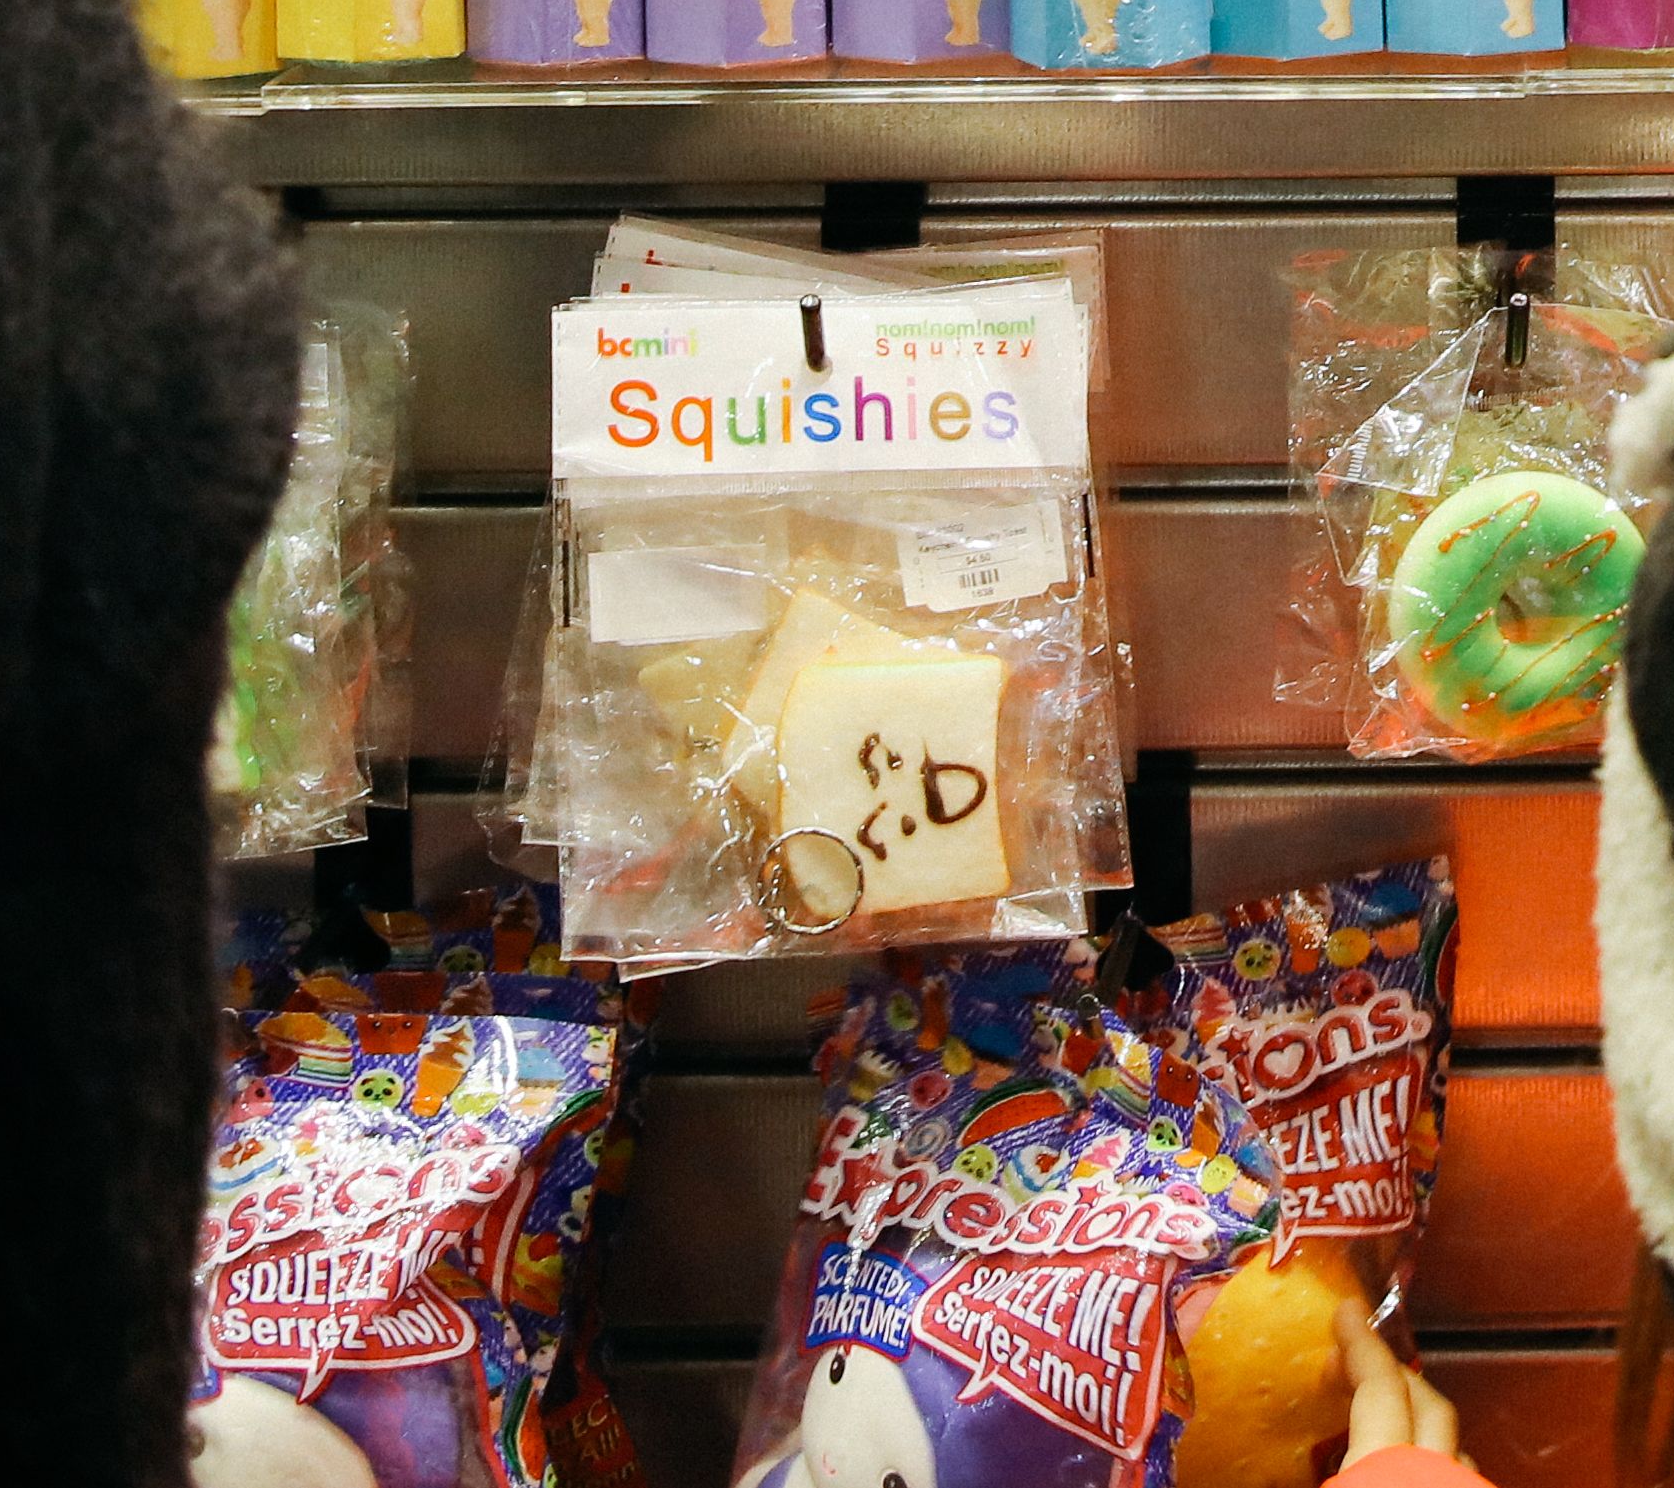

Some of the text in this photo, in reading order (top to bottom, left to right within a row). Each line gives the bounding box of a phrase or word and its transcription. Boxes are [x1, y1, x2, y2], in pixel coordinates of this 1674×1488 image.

[597, 327, 698, 358] bcmini
[876, 315, 1035, 338] nom!nom!nom!
[608, 376, 1019, 463] Squishies
[227, 1240, 391, 1306] SQUEEZE
[219, 1288, 459, 1350] Serrez-moi!
[958, 1264, 1160, 1373] SQUEEZE ME!
[933, 1291, 1135, 1448] Serrez-moi!
